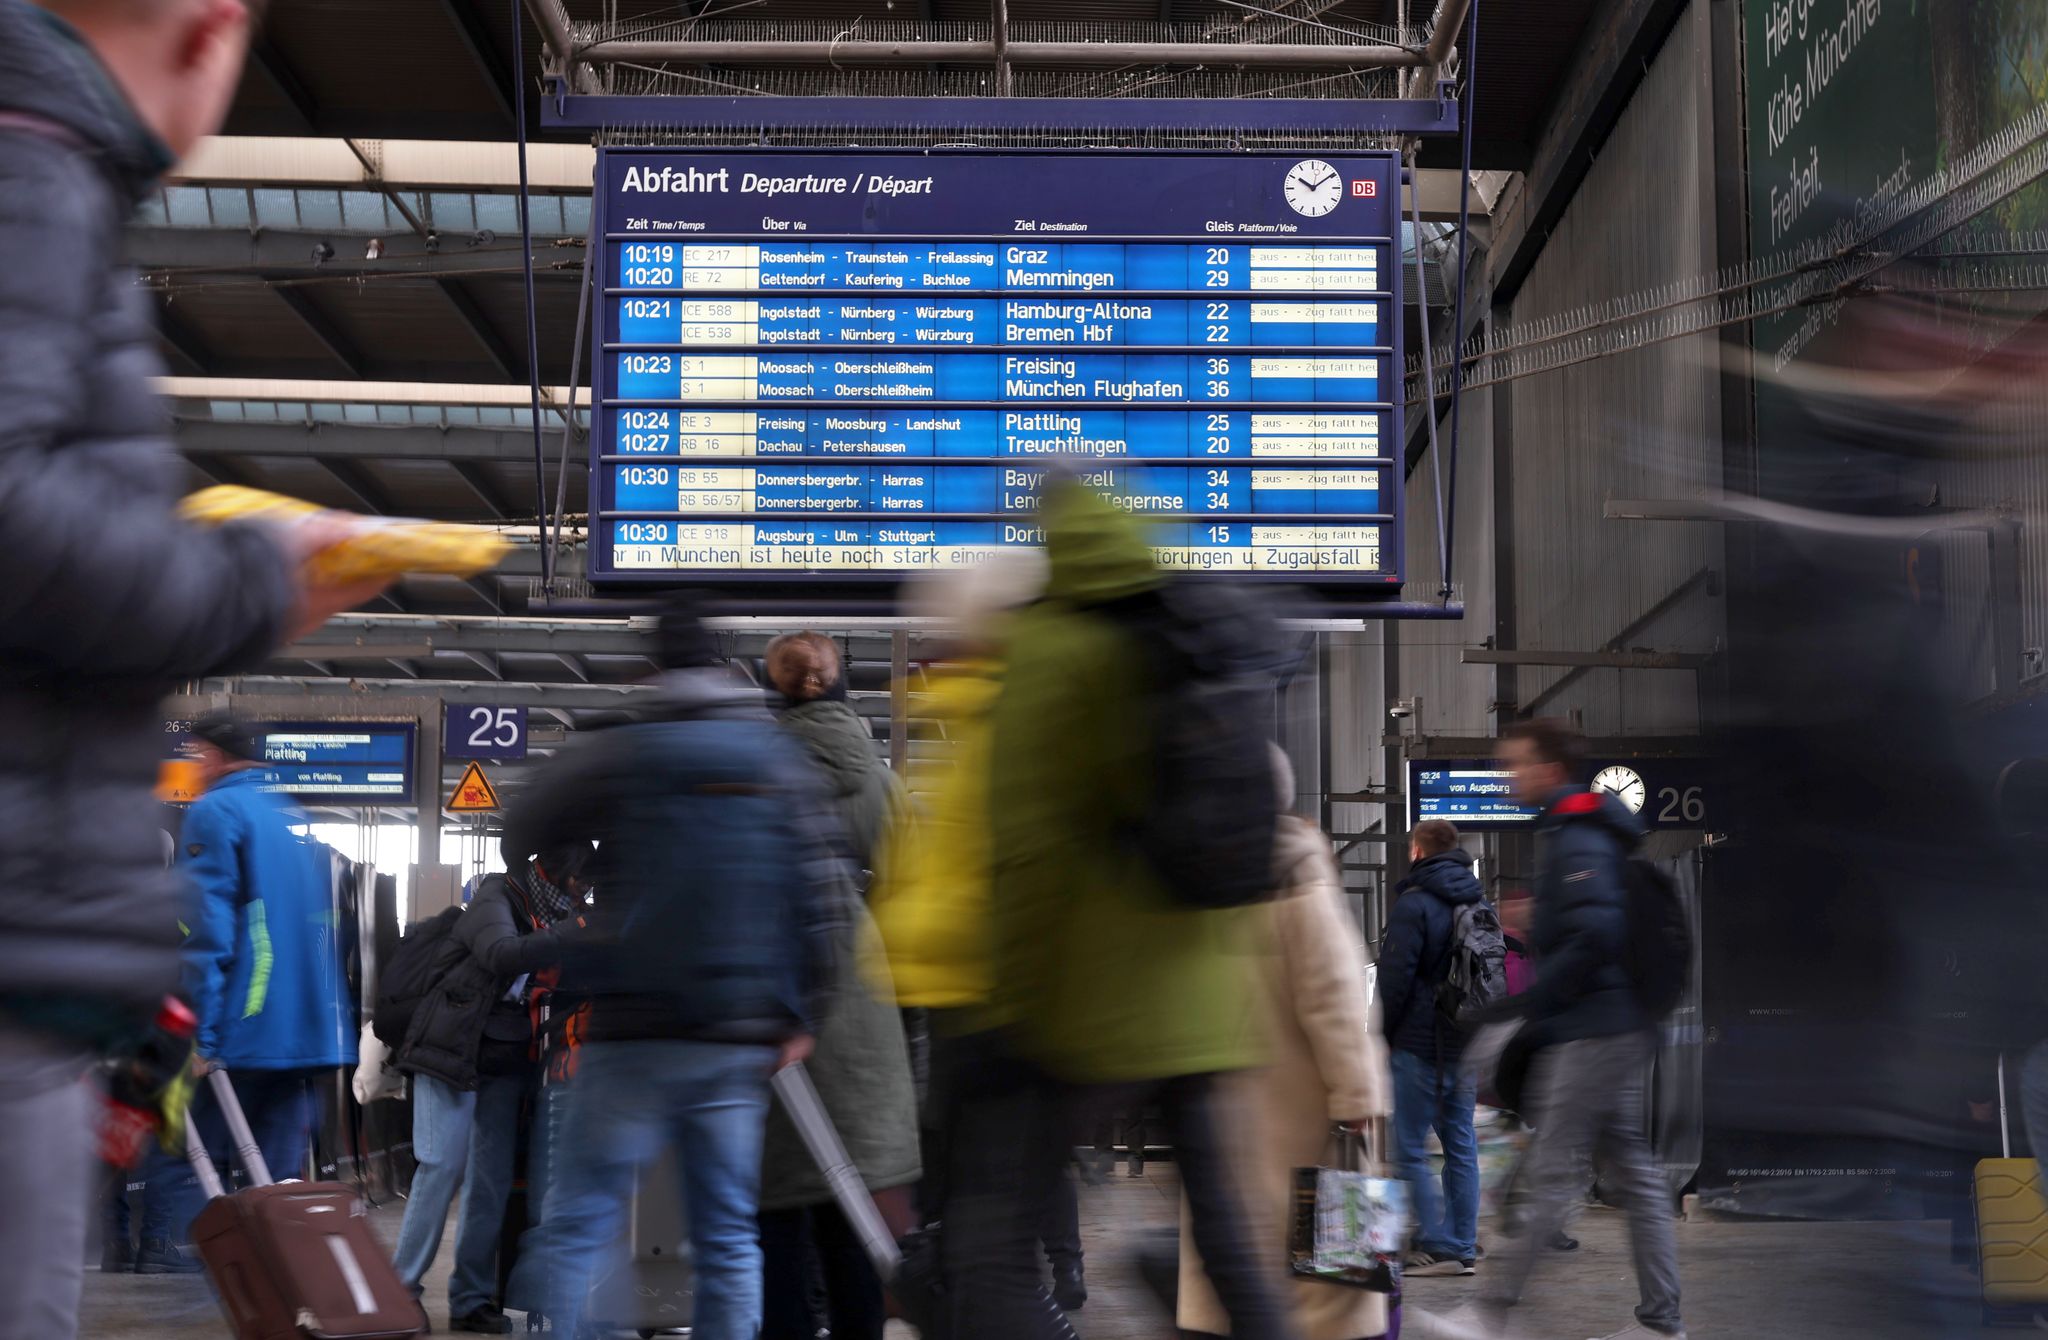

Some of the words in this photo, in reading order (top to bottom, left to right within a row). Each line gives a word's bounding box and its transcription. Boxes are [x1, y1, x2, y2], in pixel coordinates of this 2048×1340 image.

[1767, 74, 1802, 156] Kühe
[622, 167, 729, 193] Abfahrt
[740, 173, 846, 196] Departure
[852, 174, 863, 193] /
[867, 175, 932, 196] Départ
[1354, 183, 1374, 194] DB
[1770, 146, 1822, 245] Freiheit.
[627, 219, 648, 229] Zeit
[652, 221, 705, 231] Time/Temps
[762, 218, 789, 230] Über
[793, 221, 806, 230] Via
[1015, 220, 1035, 231] Ziel
[1040, 222, 1087, 231] Destination
[1206, 221, 1234, 232] Gleis
[1238, 223, 1297, 233] Platform/Voie
[625, 246, 673, 262] 10:19
[684, 251, 699, 262] EC
[707, 250, 730, 261] 217
[761, 252, 824, 264] Rosenheim
[845, 252, 908, 264] Traunstein
[928, 252, 994, 266] Freilassing
[1007, 247, 1048, 264] Graz
[1206, 249, 1229, 264] 20
[625, 268, 672, 285] 10:20
[684, 273, 698, 284] RE
[707, 272, 722, 282] 72
[761, 274, 825, 285] Geltendorf
[845, 274, 903, 288] Kaufering
[923, 274, 970, 286] Buchloe
[1006, 269, 1114, 289] Memmingen
[1206, 271, 1229, 287] 29
[624, 301, 670, 318] 10:21
[683, 305, 701, 317] ICE
[707, 304, 732, 316] 588
[760, 307, 821, 321] Ingolstadt
[841, 307, 895, 321] Nürnberg
[916, 307, 973, 321] Würzburg
[1006, 302, 1152, 322] Hamburg-Altona
[1206, 304, 1229, 319] 22
[683, 327, 701, 338] ICE
[707, 327, 732, 338] 538
[760, 329, 821, 343] Ingolstadt
[841, 329, 895, 343] Nürnberg
[916, 329, 973, 343] Würzburg
[1006, 324, 1074, 341] Bremen
[1083, 324, 1113, 341] Hbf
[1206, 326, 1229, 342] 22
[624, 357, 671, 373] 10:23
[683, 360, 690, 371] S
[698, 360, 704, 370] 1
[759, 362, 814, 374] Moosach
[835, 362, 933, 375] Oberschleißheim
[1006, 358, 1075, 378] Freising
[1207, 359, 1229, 375] 36
[683, 383, 690, 393] S
[698, 382, 704, 393] 1
[759, 384, 814, 396] Moosach
[835, 384, 933, 397] Oberschleißheim
[1006, 380, 1086, 397] München
[1095, 381, 1182, 400] Flughafen
[1207, 382, 1229, 397] 36
[622, 412, 669, 429] 10:24
[681, 416, 696, 427] RE
[704, 416, 711, 427] 3
[759, 419, 805, 432] Freising
[826, 419, 886, 432] Moosburg
[906, 419, 960, 431] Landshut
[1006, 415, 1081, 434] Plattling
[1207, 415, 1230, 431] 25
[622, 434, 669, 451] 10:27
[681, 439, 697, 450] RB
[706, 439, 719, 450] 16
[758, 440, 802, 452] Dachau
[823, 441, 906, 453] Petershausen
[1006, 437, 1126, 457] Treuchtlingen
[1207, 437, 1230, 453] 20
[620, 468, 668, 485] 10:30
[680, 472, 696, 484] RB
[703, 472, 718, 483] 55
[757, 474, 862, 488] Donnersbergerbr.
[882, 475, 924, 487] Harras
[1207, 471, 1230, 487] 34
[680, 494, 696, 506] RB
[702, 494, 740, 506] 56/57
[757, 497, 862, 510] Donnersbergerbr.
[882, 497, 924, 509] Harras
[1207, 493, 1230, 509] 34
[619, 524, 667, 541] 10:30
[679, 528, 697, 540] ICE
[704, 528, 728, 539] 918
[757, 530, 814, 545] Augsburg
[835, 530, 858, 542] Ulm
[878, 530, 935, 545] Stuttgart
[1209, 527, 1230, 543] 15
[638, 547, 651, 563] in
[661, 546, 740, 563] München
[750, 546, 772, 564] ist
[782, 547, 832, 564] heute
[842, 547, 883, 564] noch
[894, 548, 941, 564] stark
[1151, 549, 1233, 569] törungen
[1243, 550, 1257, 565] u.
[1267, 549, 1360, 569] Zugausfall
[164, 721, 198, 733] 26-3
[467, 707, 520, 748] 25
[265, 749, 306, 762] Plattling
[1449, 784, 1466, 792] von
[1469, 783, 1510, 794] Augsburg
[1657, 786, 1704, 822] 26
